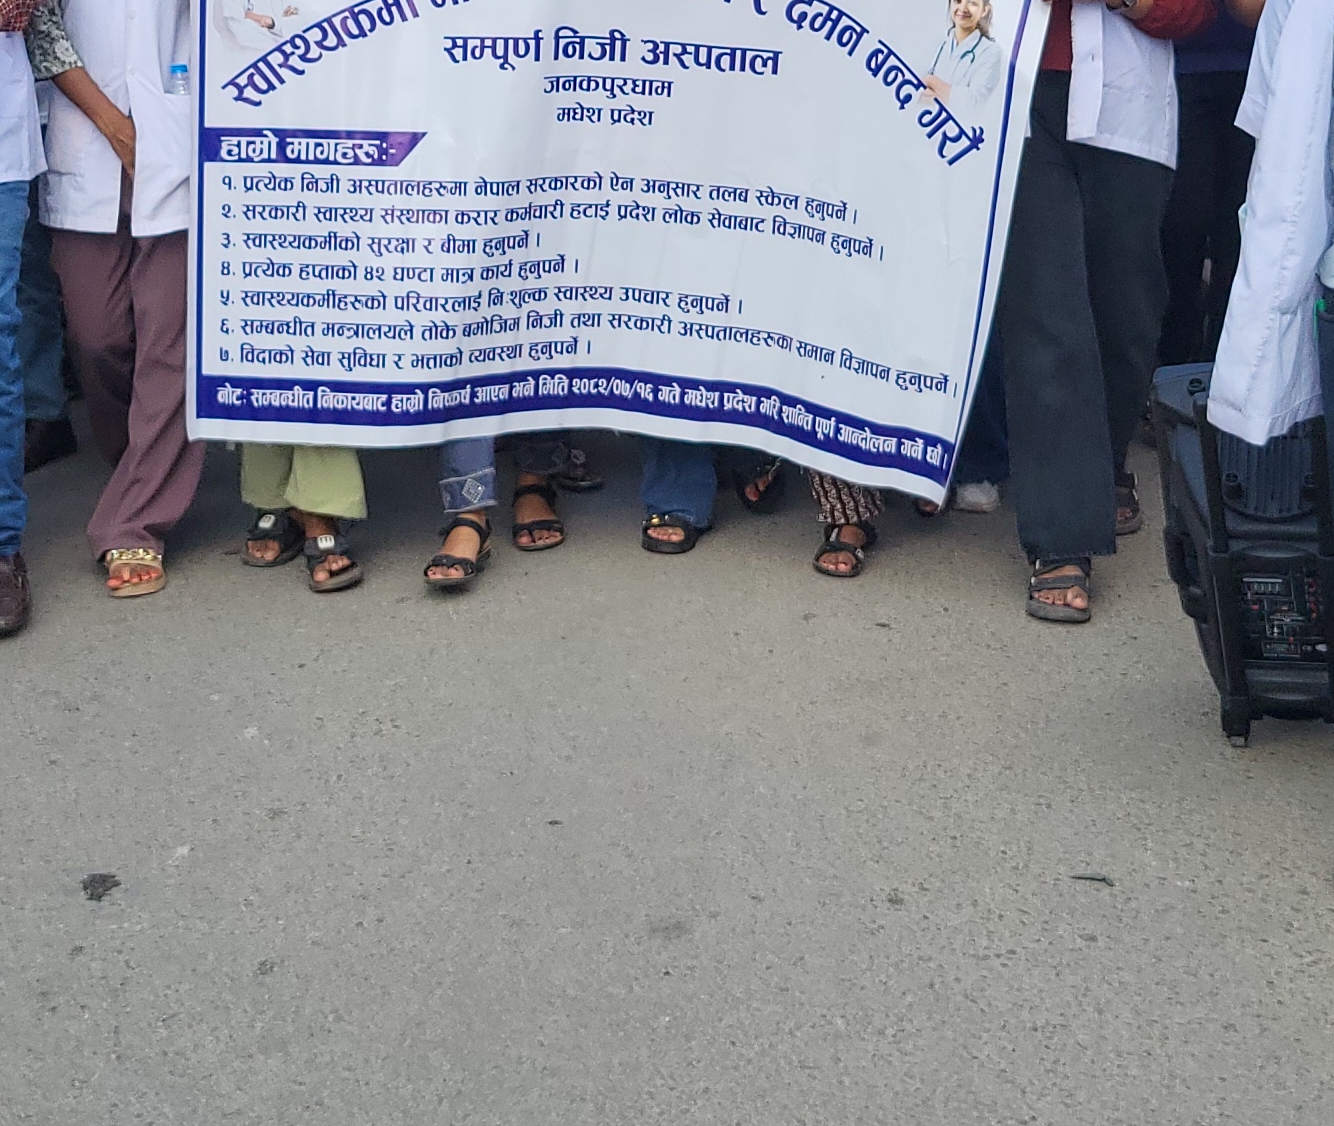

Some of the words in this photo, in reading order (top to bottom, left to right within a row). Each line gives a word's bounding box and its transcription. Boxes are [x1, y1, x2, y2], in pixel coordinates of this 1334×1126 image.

[444, 29, 543, 71] सम्पूर्ण
[553, 26, 630, 62] निजी
[640, 38, 782, 76] अस्पताल
[543, 74, 674, 100] जनकपुरधाम
[865, 39, 927, 111] बन्द
[556, 102, 603, 124] मधेश
[610, 104, 654, 127] प्रदेश
[219, 130, 278, 162] हाम्रो
[242, 171, 294, 193] प्रत्येक
[300, 172, 341, 194] निजी
[473, 176, 521, 197] नेपाल
[525, 171, 603, 195] सरकारको
[609, 171, 635, 193] ऐन
[640, 177, 704, 200] अनुसार
[708, 184, 749, 203] तलब
[755, 185, 801, 210] स्केल
[241, 201, 307, 223] सरकारी
[313, 207, 374, 225] स्वास्थ्य
[380, 204, 449, 225] संस्थाका
[454, 207, 500, 226] करार
[504, 200, 565, 224] कर्मचारी
[569, 199, 611, 221] हटाई
[617, 200, 657, 223] प्रदेश
[662, 203, 702, 226] लोक
[707, 207, 767, 233] सेवाबाट
[772, 214, 827, 247] विज्ञापन
[241, 230, 362, 252] स्वास्थ्यकर्मीको
[367, 236, 417, 257] सुरक्षा
[422, 237, 436, 254] र
[440, 233, 478, 255] बीमा
[241, 256, 294, 280] प्रत्येक
[298, 259, 358, 282] हप्ताको
[364, 266, 387, 282] ४२
[392, 265, 436, 283] घण्टा
[441, 266, 476, 284] मात्र
[480, 259, 513, 282] कार्य
[394, 290, 482, 313] परिवारलाई
[554, 285, 614, 302] स्वास्थ्य
[619, 286, 673, 307] उपचार
[239, 315, 317, 338] सम्बन्धीत
[321, 319, 414, 341] मन्त्रालयले
[421, 319, 458, 342] तोके
[462, 315, 521, 340] बमोजिम
[526, 308, 565, 331] निजी
[570, 312, 603, 329] तथा
[607, 313, 674, 335] सरकारी
[795, 339, 836, 365] समान
[839, 347, 892, 383] विज्ञापन
[239, 343, 294, 366] विदाको
[301, 345, 332, 367] सेवा
[337, 347, 387, 373] सुविधा
[392, 352, 406, 369] र
[411, 347, 463, 370] भत्ताको
[468, 341, 523, 364] व्यवस्था
[251, 386, 314, 411] सम्बन्धीत
[317, 388, 387, 413] निकायबाट
[390, 390, 423, 413] हाम्रो
[474, 384, 509, 405] आएन
[512, 377, 536, 400] भने
[538, 374, 569, 397] मिति
[572, 376, 654, 402] २०८२/०७/१६
[658, 383, 681, 405] गते
[684, 387, 719, 409] मधेश
[723, 389, 757, 413] प्रदेश
[759, 395, 780, 420] भरि
[781, 402, 813, 432] शान्ति
[815, 416, 836, 443] पूर्ण
[837, 427, 898, 454] आन्दोलन
